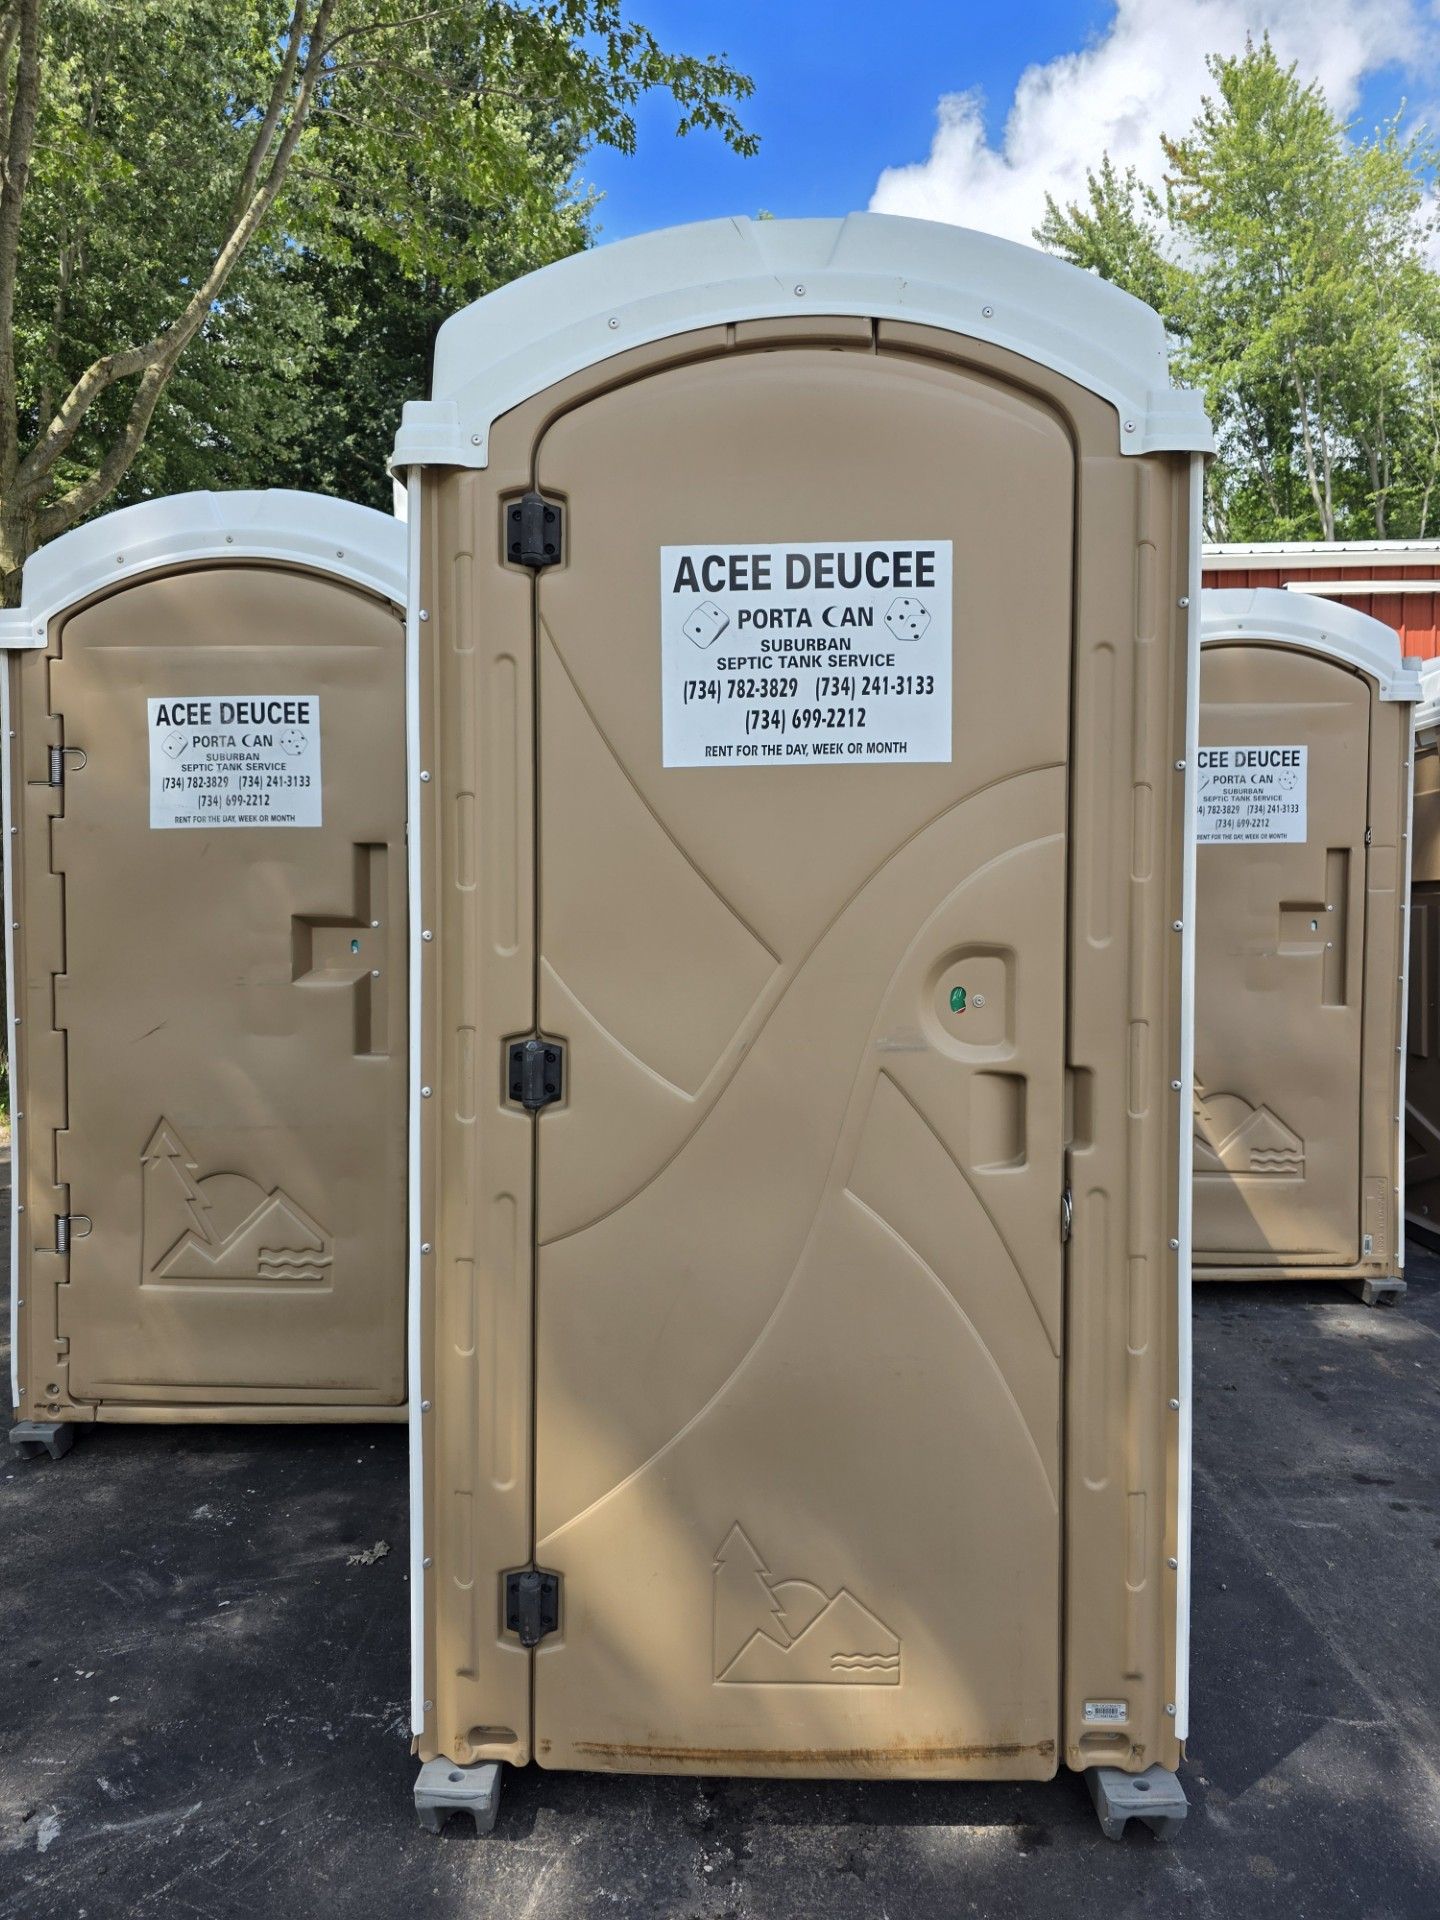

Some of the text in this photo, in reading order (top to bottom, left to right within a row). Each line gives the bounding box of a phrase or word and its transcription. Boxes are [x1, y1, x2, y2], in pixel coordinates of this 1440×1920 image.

[672, 550, 935, 593] ACEE DEUCEE
[738, 605, 874, 629] PORTA CAN
[761, 638, 851, 652] SUBURBAN
[717, 654, 895, 671] SEPTIC TANK SERVICE
[684, 676, 934, 704] (734) 782-3829 (734) 241-3133
[156, 702, 309, 726] ACEE DEUCEE
[745, 708, 866, 734] (734) 699-2212
[193, 734, 273, 748] PORTA CAN
[206, 753, 260, 761] SUBURBAN
[705, 742, 907, 757] RENT FOR THE DAY, WEEK OR MONTH
[1198, 751, 1300, 768] CEE DEUCEE
[182, 764, 213, 772] SEPTIC
[163, 776, 310, 792] (734) 782-3829 (734) 241-3133
[1213, 775, 1246, 784] PORTA
[198, 795, 270, 809] (734) 699-2212
[1208, 806, 1240, 814] 782-3829
[1247, 805, 1265, 815] (734)
[1268, 804, 1298, 813] 241-3133
[1216, 819, 1234, 830] (734)
